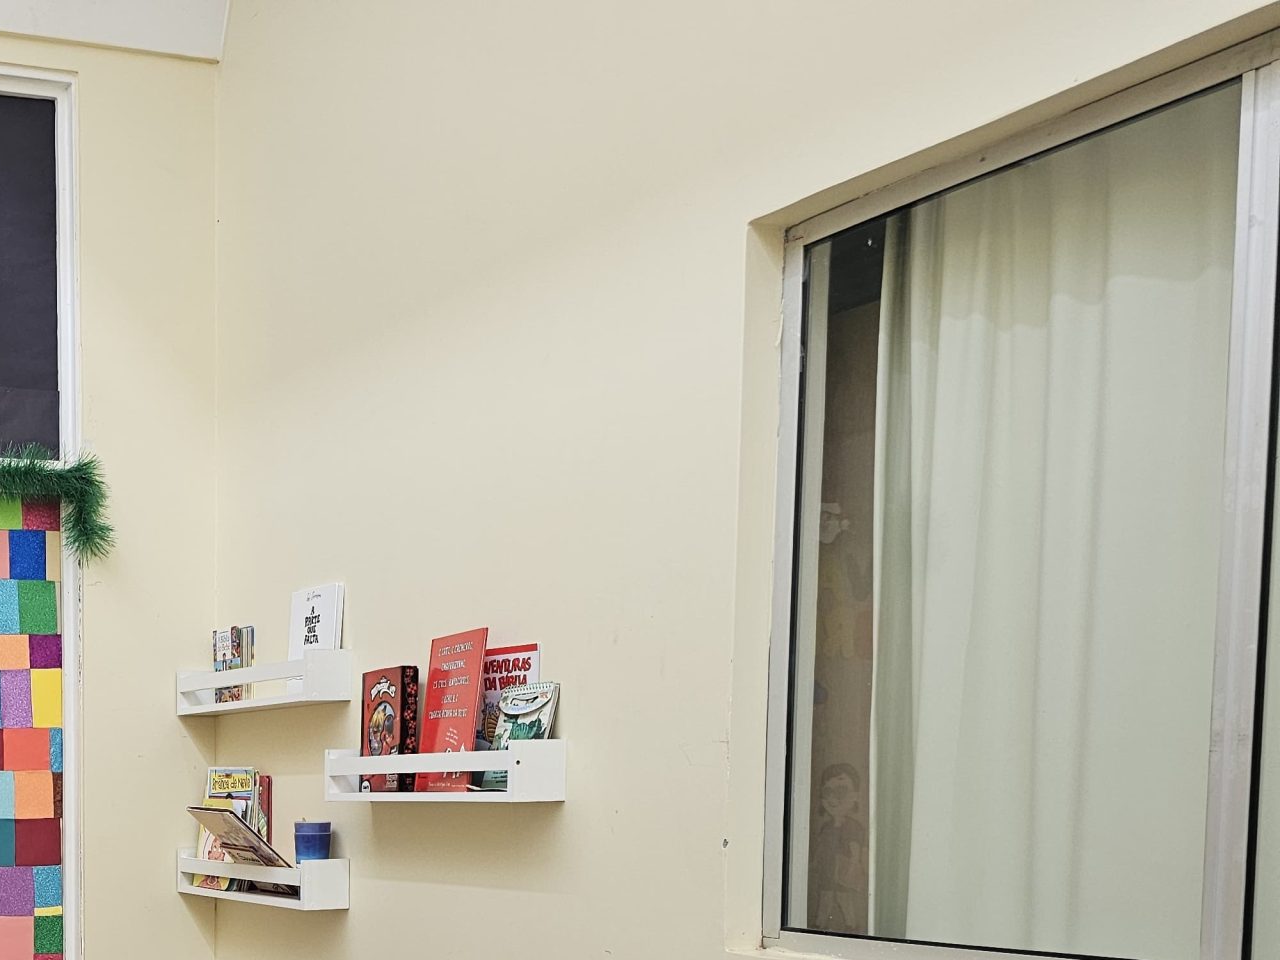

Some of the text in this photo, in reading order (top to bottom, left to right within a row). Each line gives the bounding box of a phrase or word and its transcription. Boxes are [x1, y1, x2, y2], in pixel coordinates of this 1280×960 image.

[304, 614, 321, 627] PARTE
[306, 625, 317, 634] QUE
[303, 633, 319, 646] FALTA
[483, 676, 497, 692] DA
